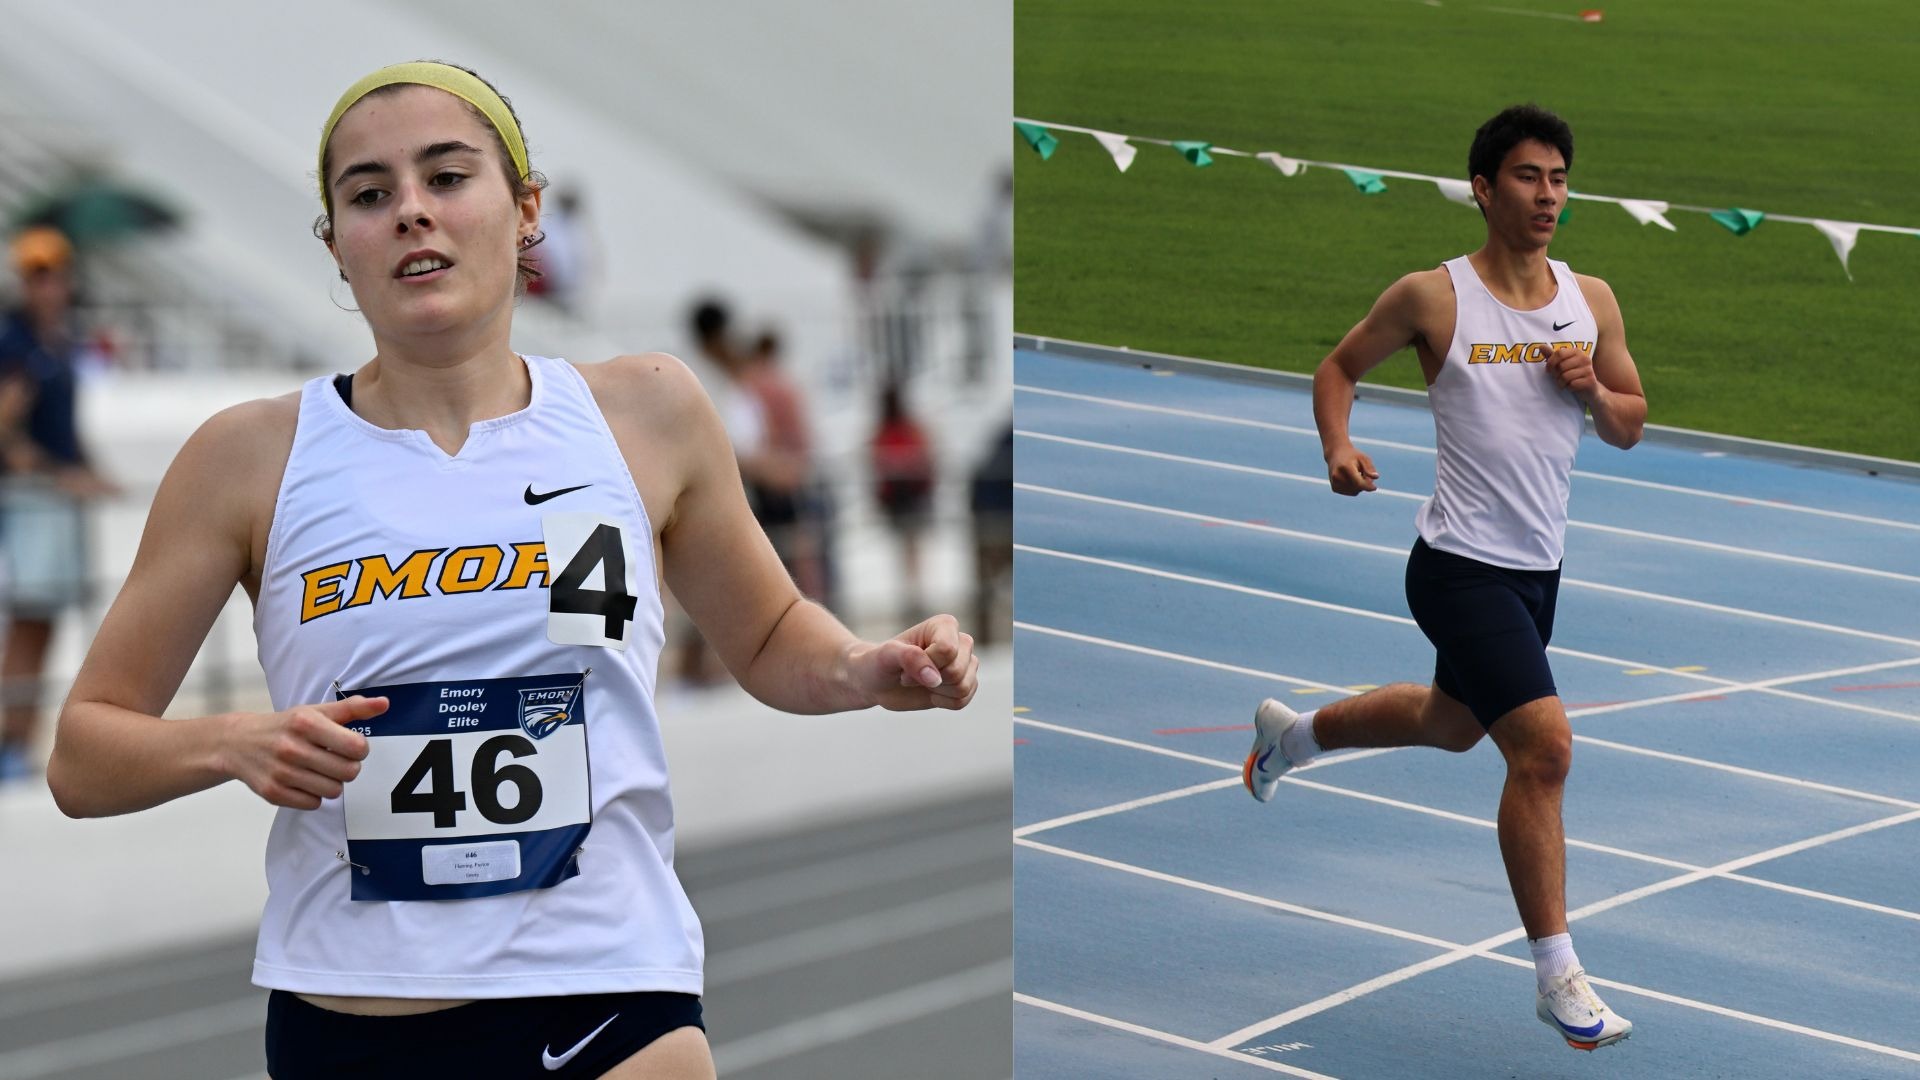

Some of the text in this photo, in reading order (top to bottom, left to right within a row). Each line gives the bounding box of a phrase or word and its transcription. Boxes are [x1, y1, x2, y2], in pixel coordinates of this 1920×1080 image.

[300, 541, 551, 625] EMOR
[550, 523, 638, 641] 4
[438, 701, 487, 714] Dooley
[440, 687, 485, 698] Emory
[447, 716, 479, 728] Elite
[391, 734, 543, 828] 46
